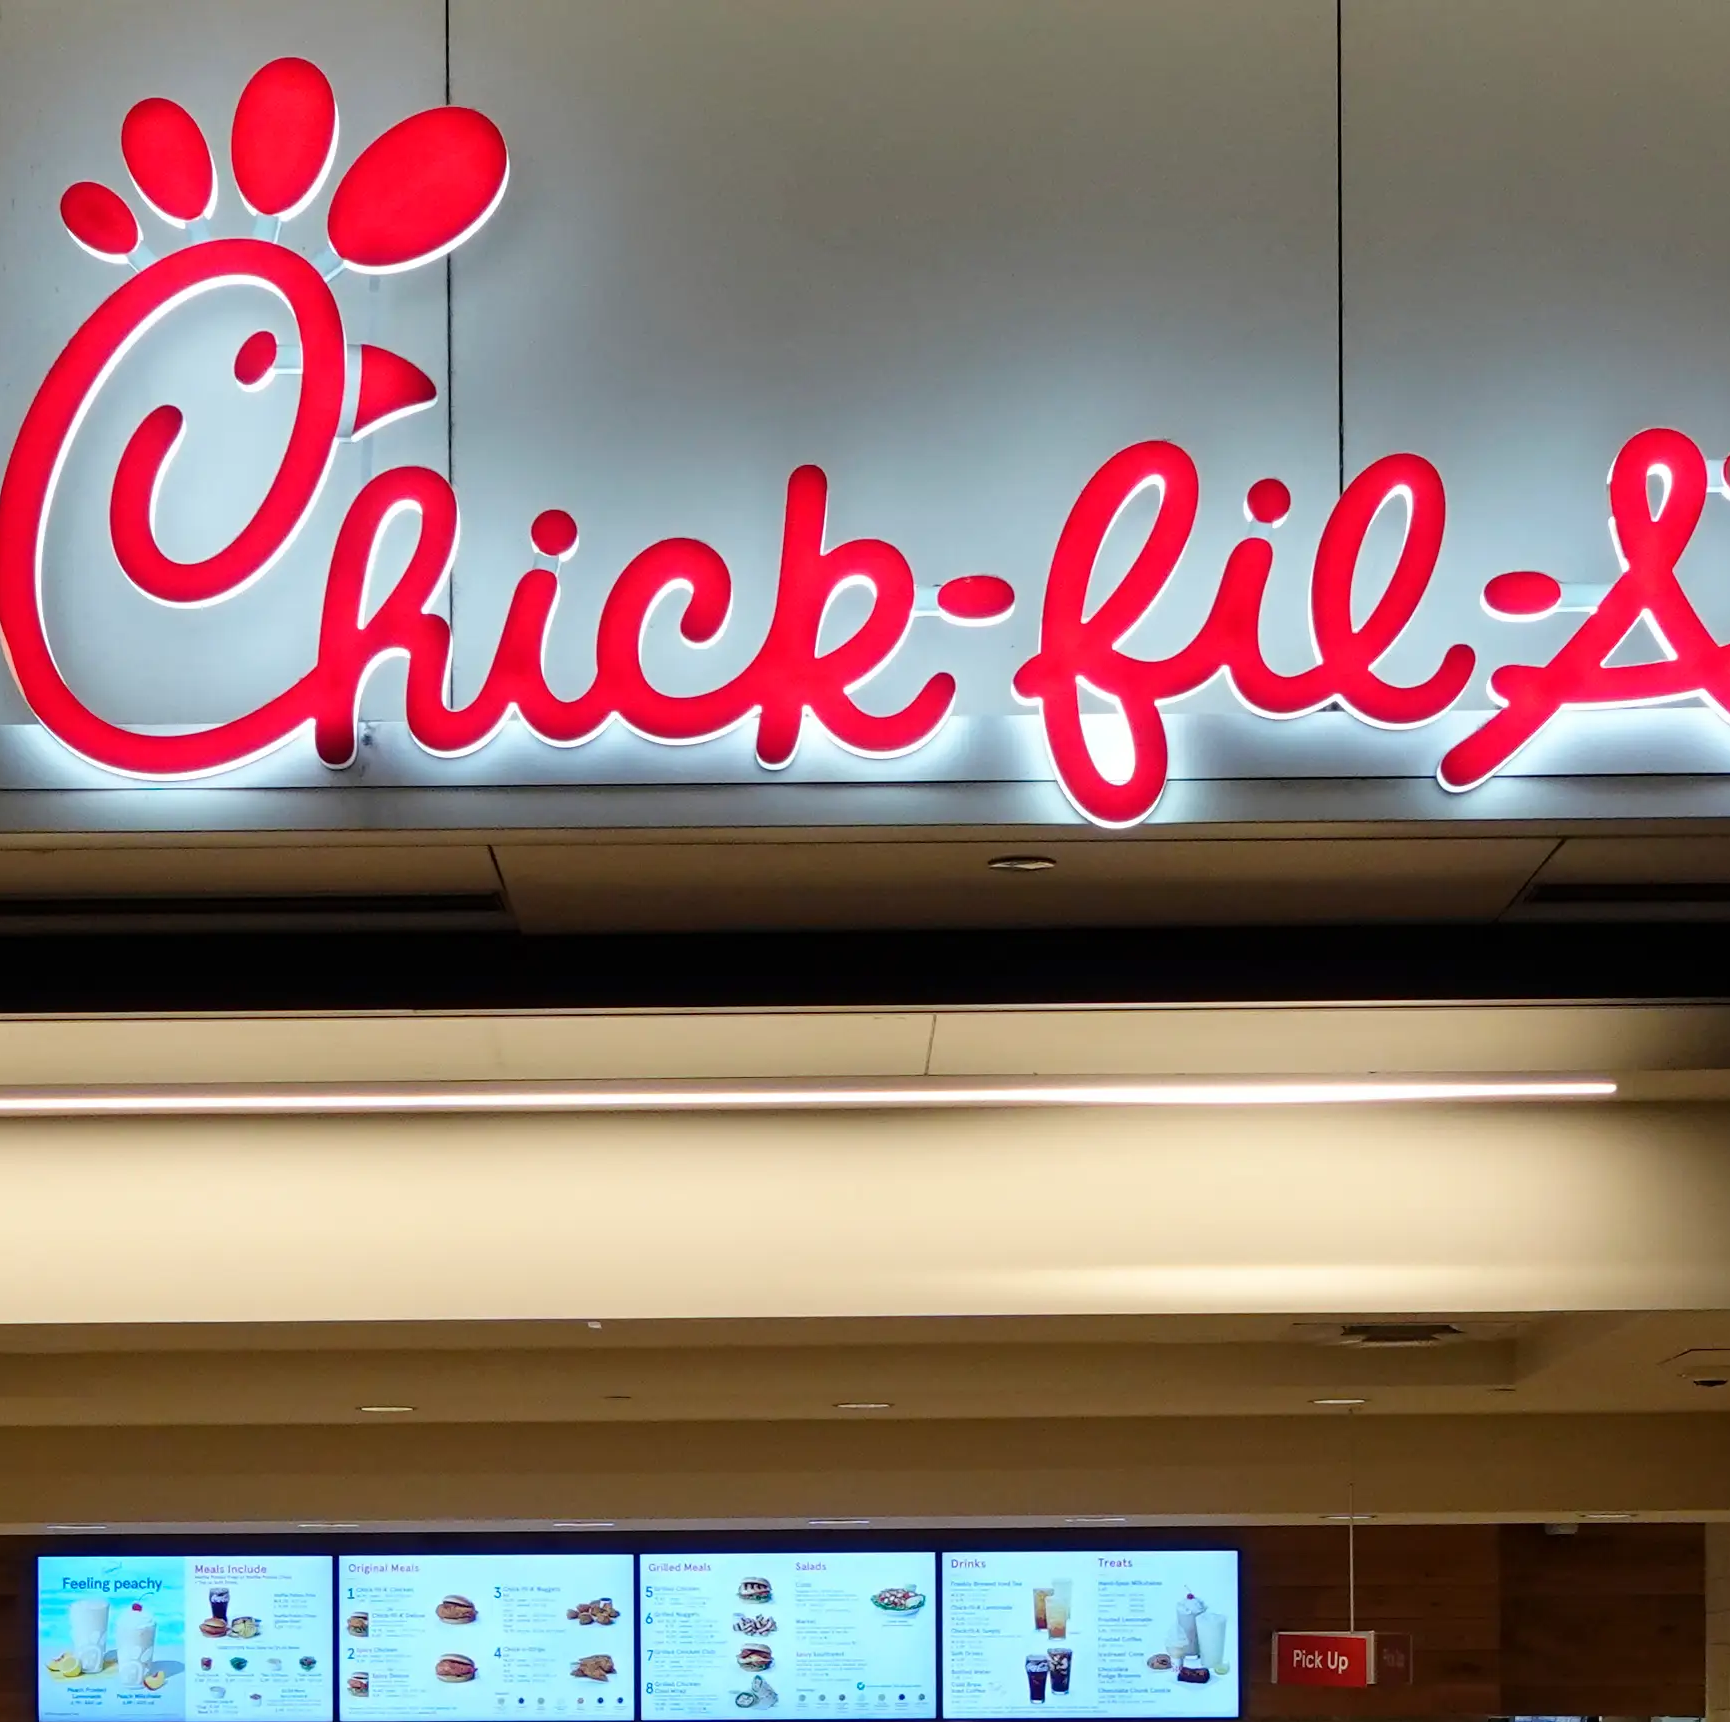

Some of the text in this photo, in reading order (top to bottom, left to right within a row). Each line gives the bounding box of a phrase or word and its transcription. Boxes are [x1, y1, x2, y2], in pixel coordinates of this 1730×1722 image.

[649, 1563, 711, 1572] Grilled Meals
[796, 1562, 826, 1571] Salads
[951, 1559, 986, 1568] Drinks
[1098, 1558, 1133, 1568] Treats
[195, 1565, 267, 1574] Meals Include
[349, 1564, 419, 1574] Original Meals
[62, 1577, 163, 1592] Feeling peachy
[347, 1588, 355, 1599] 1
[494, 1587, 502, 1598] 3
[646, 1587, 653, 1598] 5
[646, 1613, 653, 1624] 6
[347, 1648, 355, 1659] 2
[494, 1647, 502, 1659] 4
[647, 1650, 653, 1661] 7
[1293, 1649, 1349, 1675] Pick Up
[646, 1682, 653, 1694] 8
